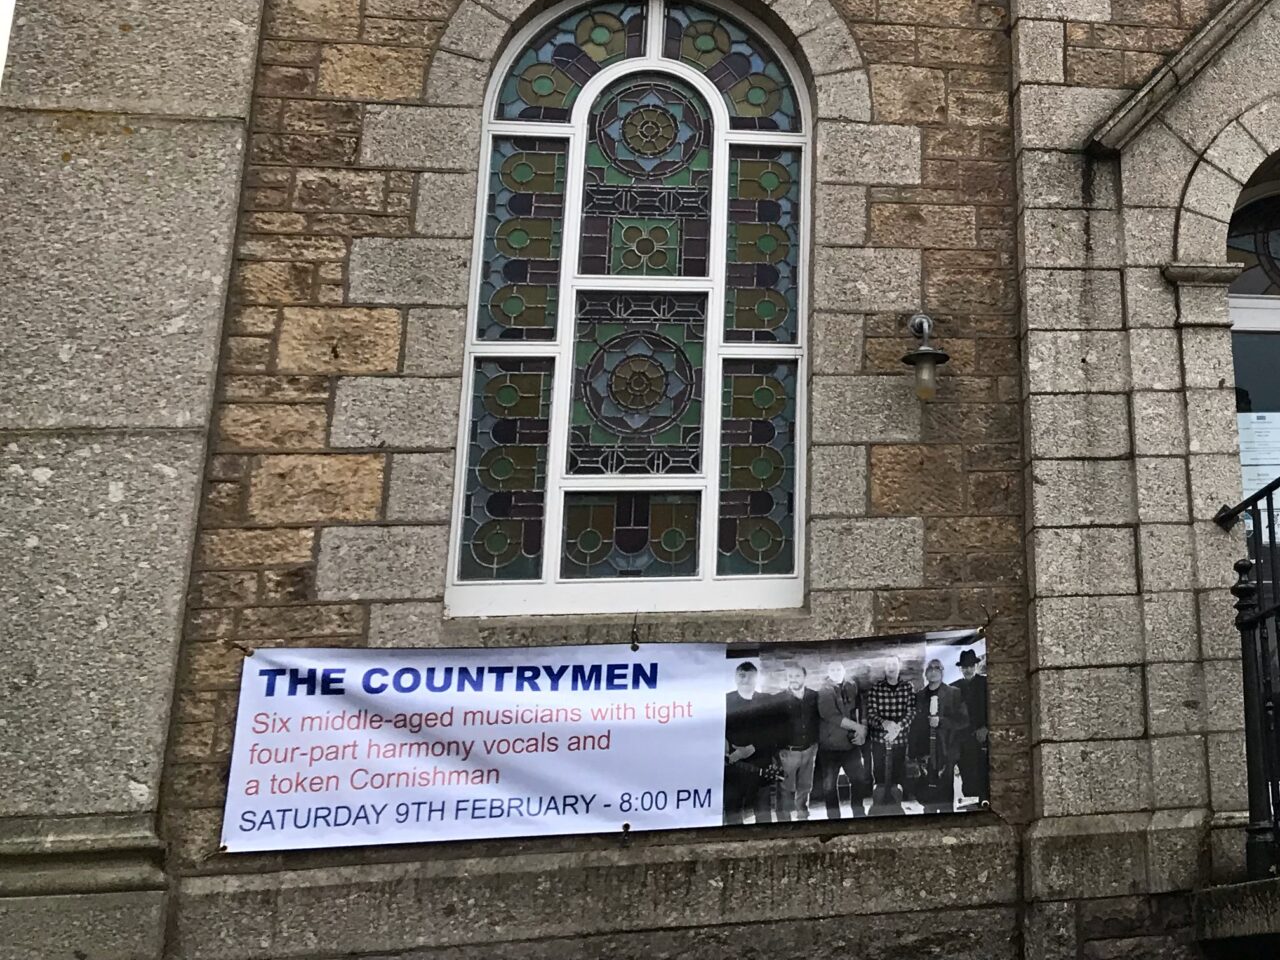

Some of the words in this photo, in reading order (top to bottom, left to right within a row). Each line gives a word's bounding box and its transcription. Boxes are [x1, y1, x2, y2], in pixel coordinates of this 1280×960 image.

[259, 667, 347, 697] THE
[362, 662, 658, 695] COUNTRYMEN
[252, 712, 292, 734] Six
[300, 707, 454, 733] middle-aged
[463, 704, 582, 726] musicians
[590, 702, 636, 722] with
[645, 701, 693, 724] tight
[249, 739, 359, 767] four-part
[367, 738, 475, 761] harmony
[483, 732, 559, 755] vocals
[567, 729, 611, 751] and
[244, 779, 260, 795] a
[270, 772, 339, 794] token
[350, 766, 500, 790] Cornishman
[239, 803, 389, 832] SATURDAY
[395, 800, 445, 824] 9TH
[455, 793, 597, 821] FEBRUARY
[619, 790, 668, 813] 8:00
[675, 788, 712, 810] PM
